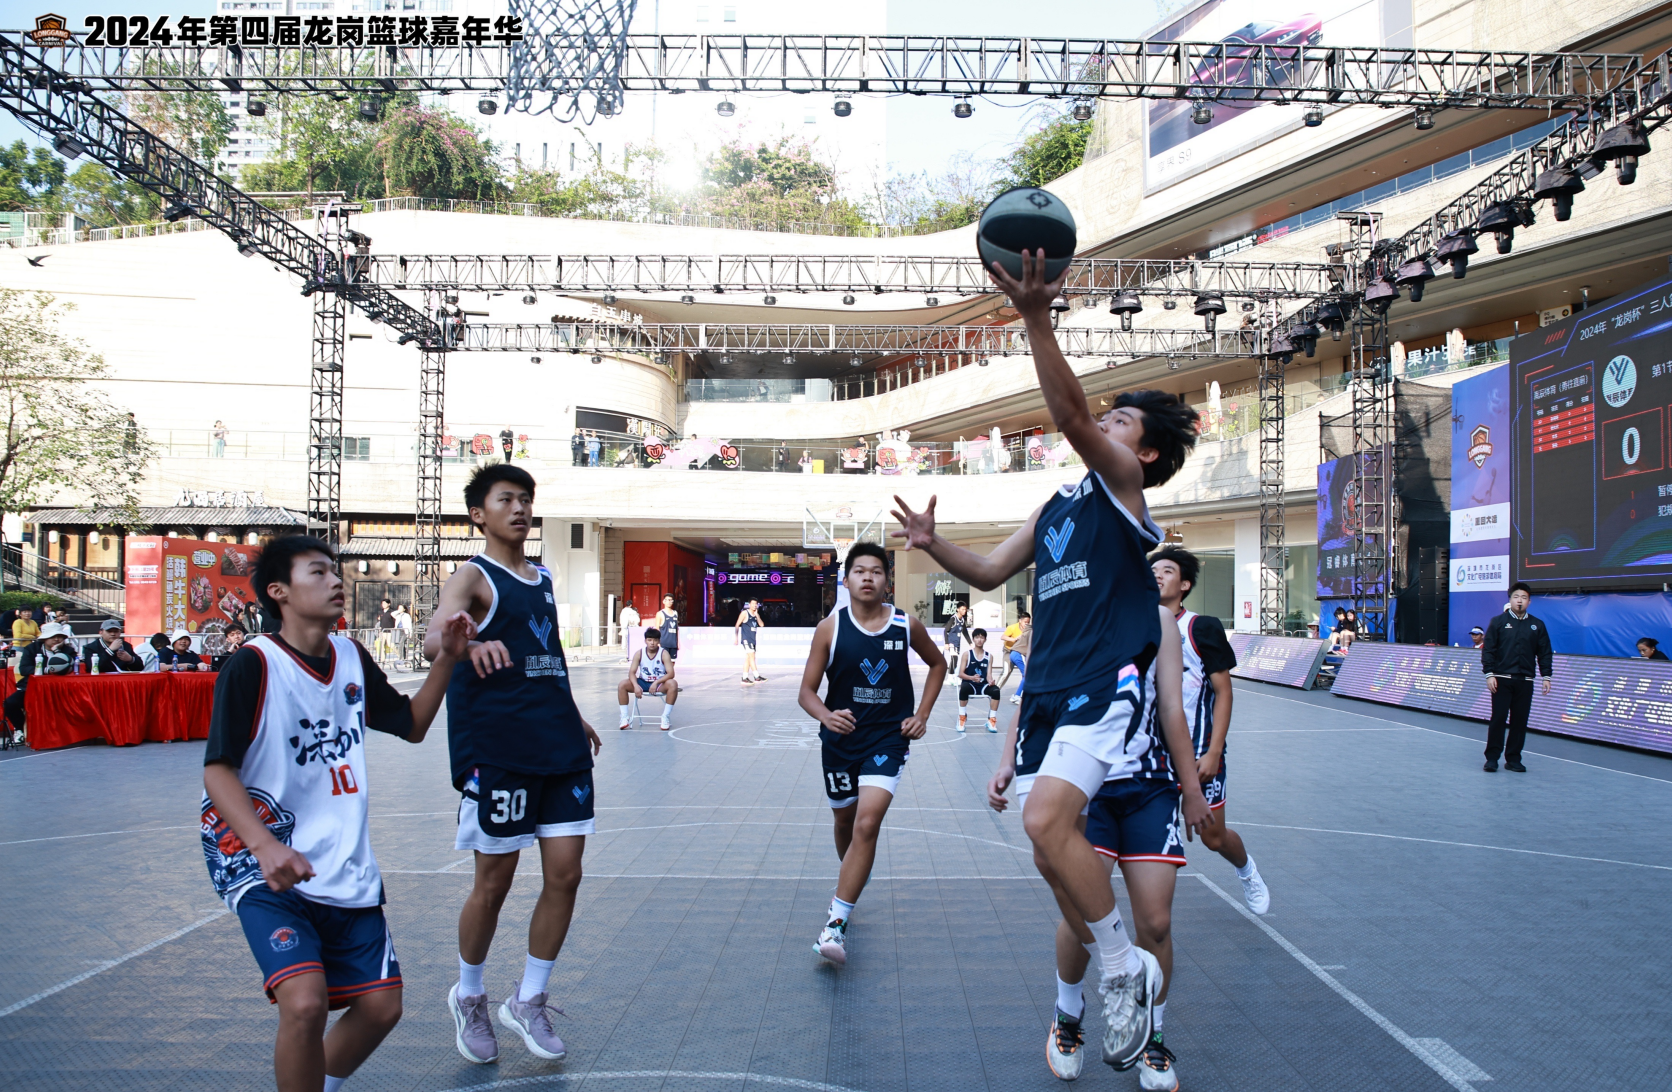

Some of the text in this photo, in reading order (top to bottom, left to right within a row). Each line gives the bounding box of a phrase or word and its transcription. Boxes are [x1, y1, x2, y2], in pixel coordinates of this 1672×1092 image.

[1179, 148, 1192, 165] S9
[1580, 321, 1607, 341] 2024年
[1622, 427, 1640, 465] 0
[730, 573, 768, 584] game
[883, 640, 904, 651] 深圳
[330, 764, 359, 796] 10
[827, 771, 852, 793] 13
[490, 788, 527, 824] 30
